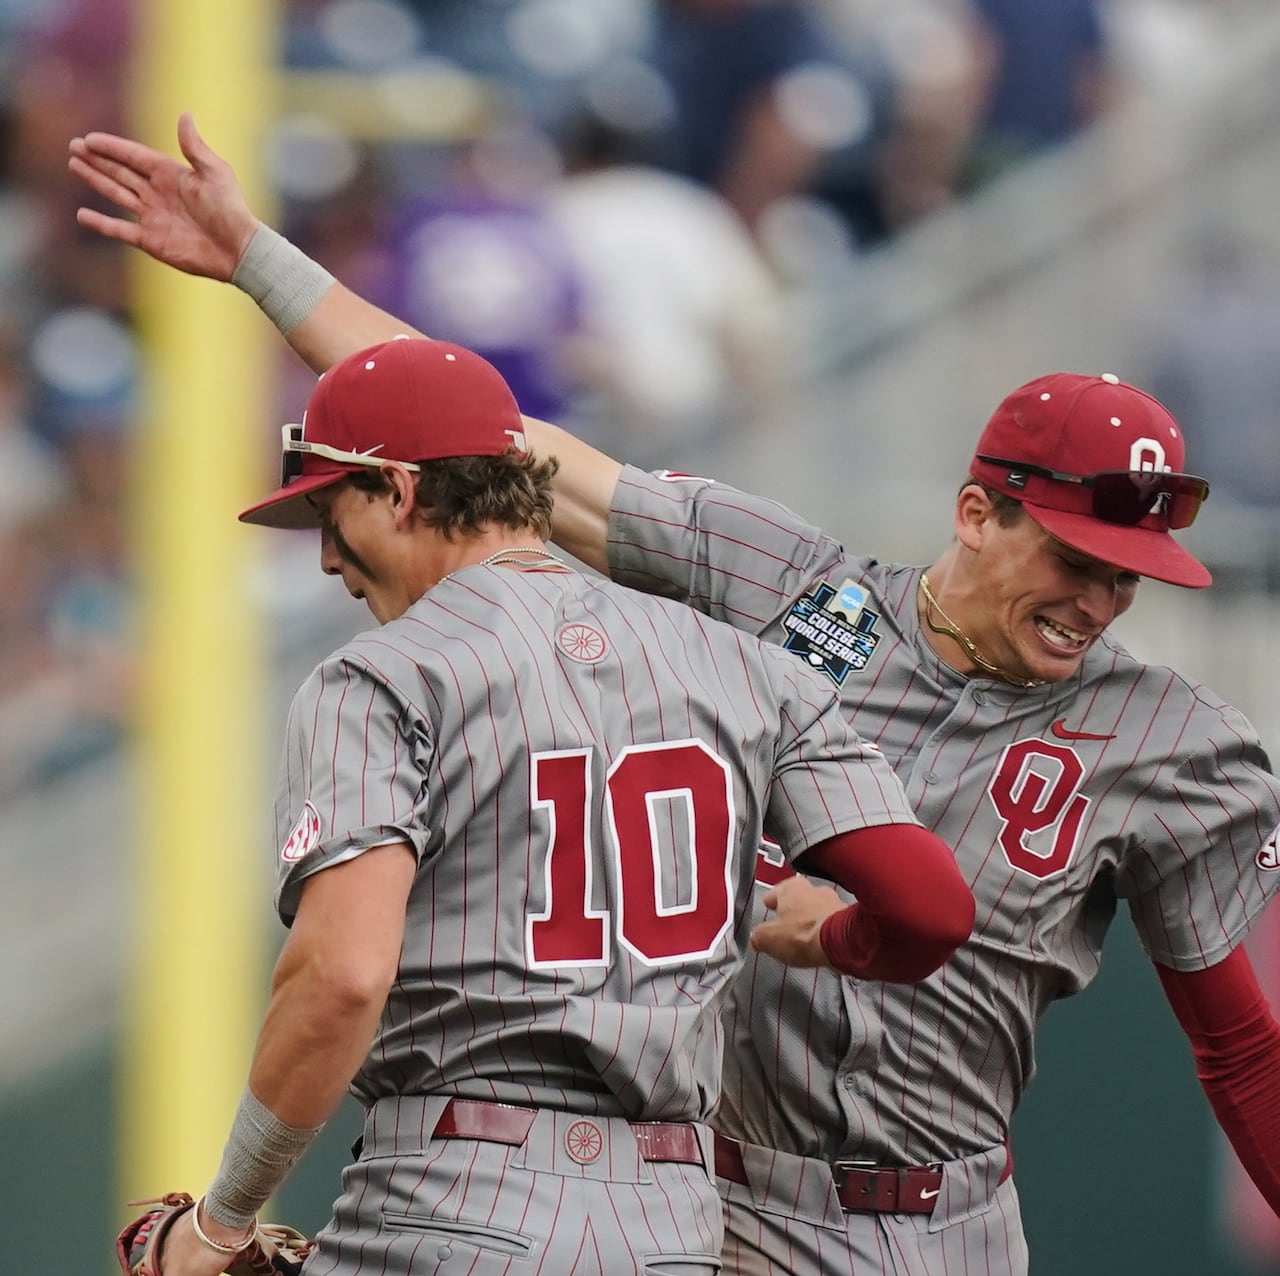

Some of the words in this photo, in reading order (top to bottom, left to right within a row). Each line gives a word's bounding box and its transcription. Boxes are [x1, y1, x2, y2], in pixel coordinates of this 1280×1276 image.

[785, 614, 828, 645] WORLD
[824, 638, 867, 668] SERIES
[808, 613, 858, 648] COLLEGE
[526, 738, 736, 969] 10
[988, 738, 1091, 881] OU
